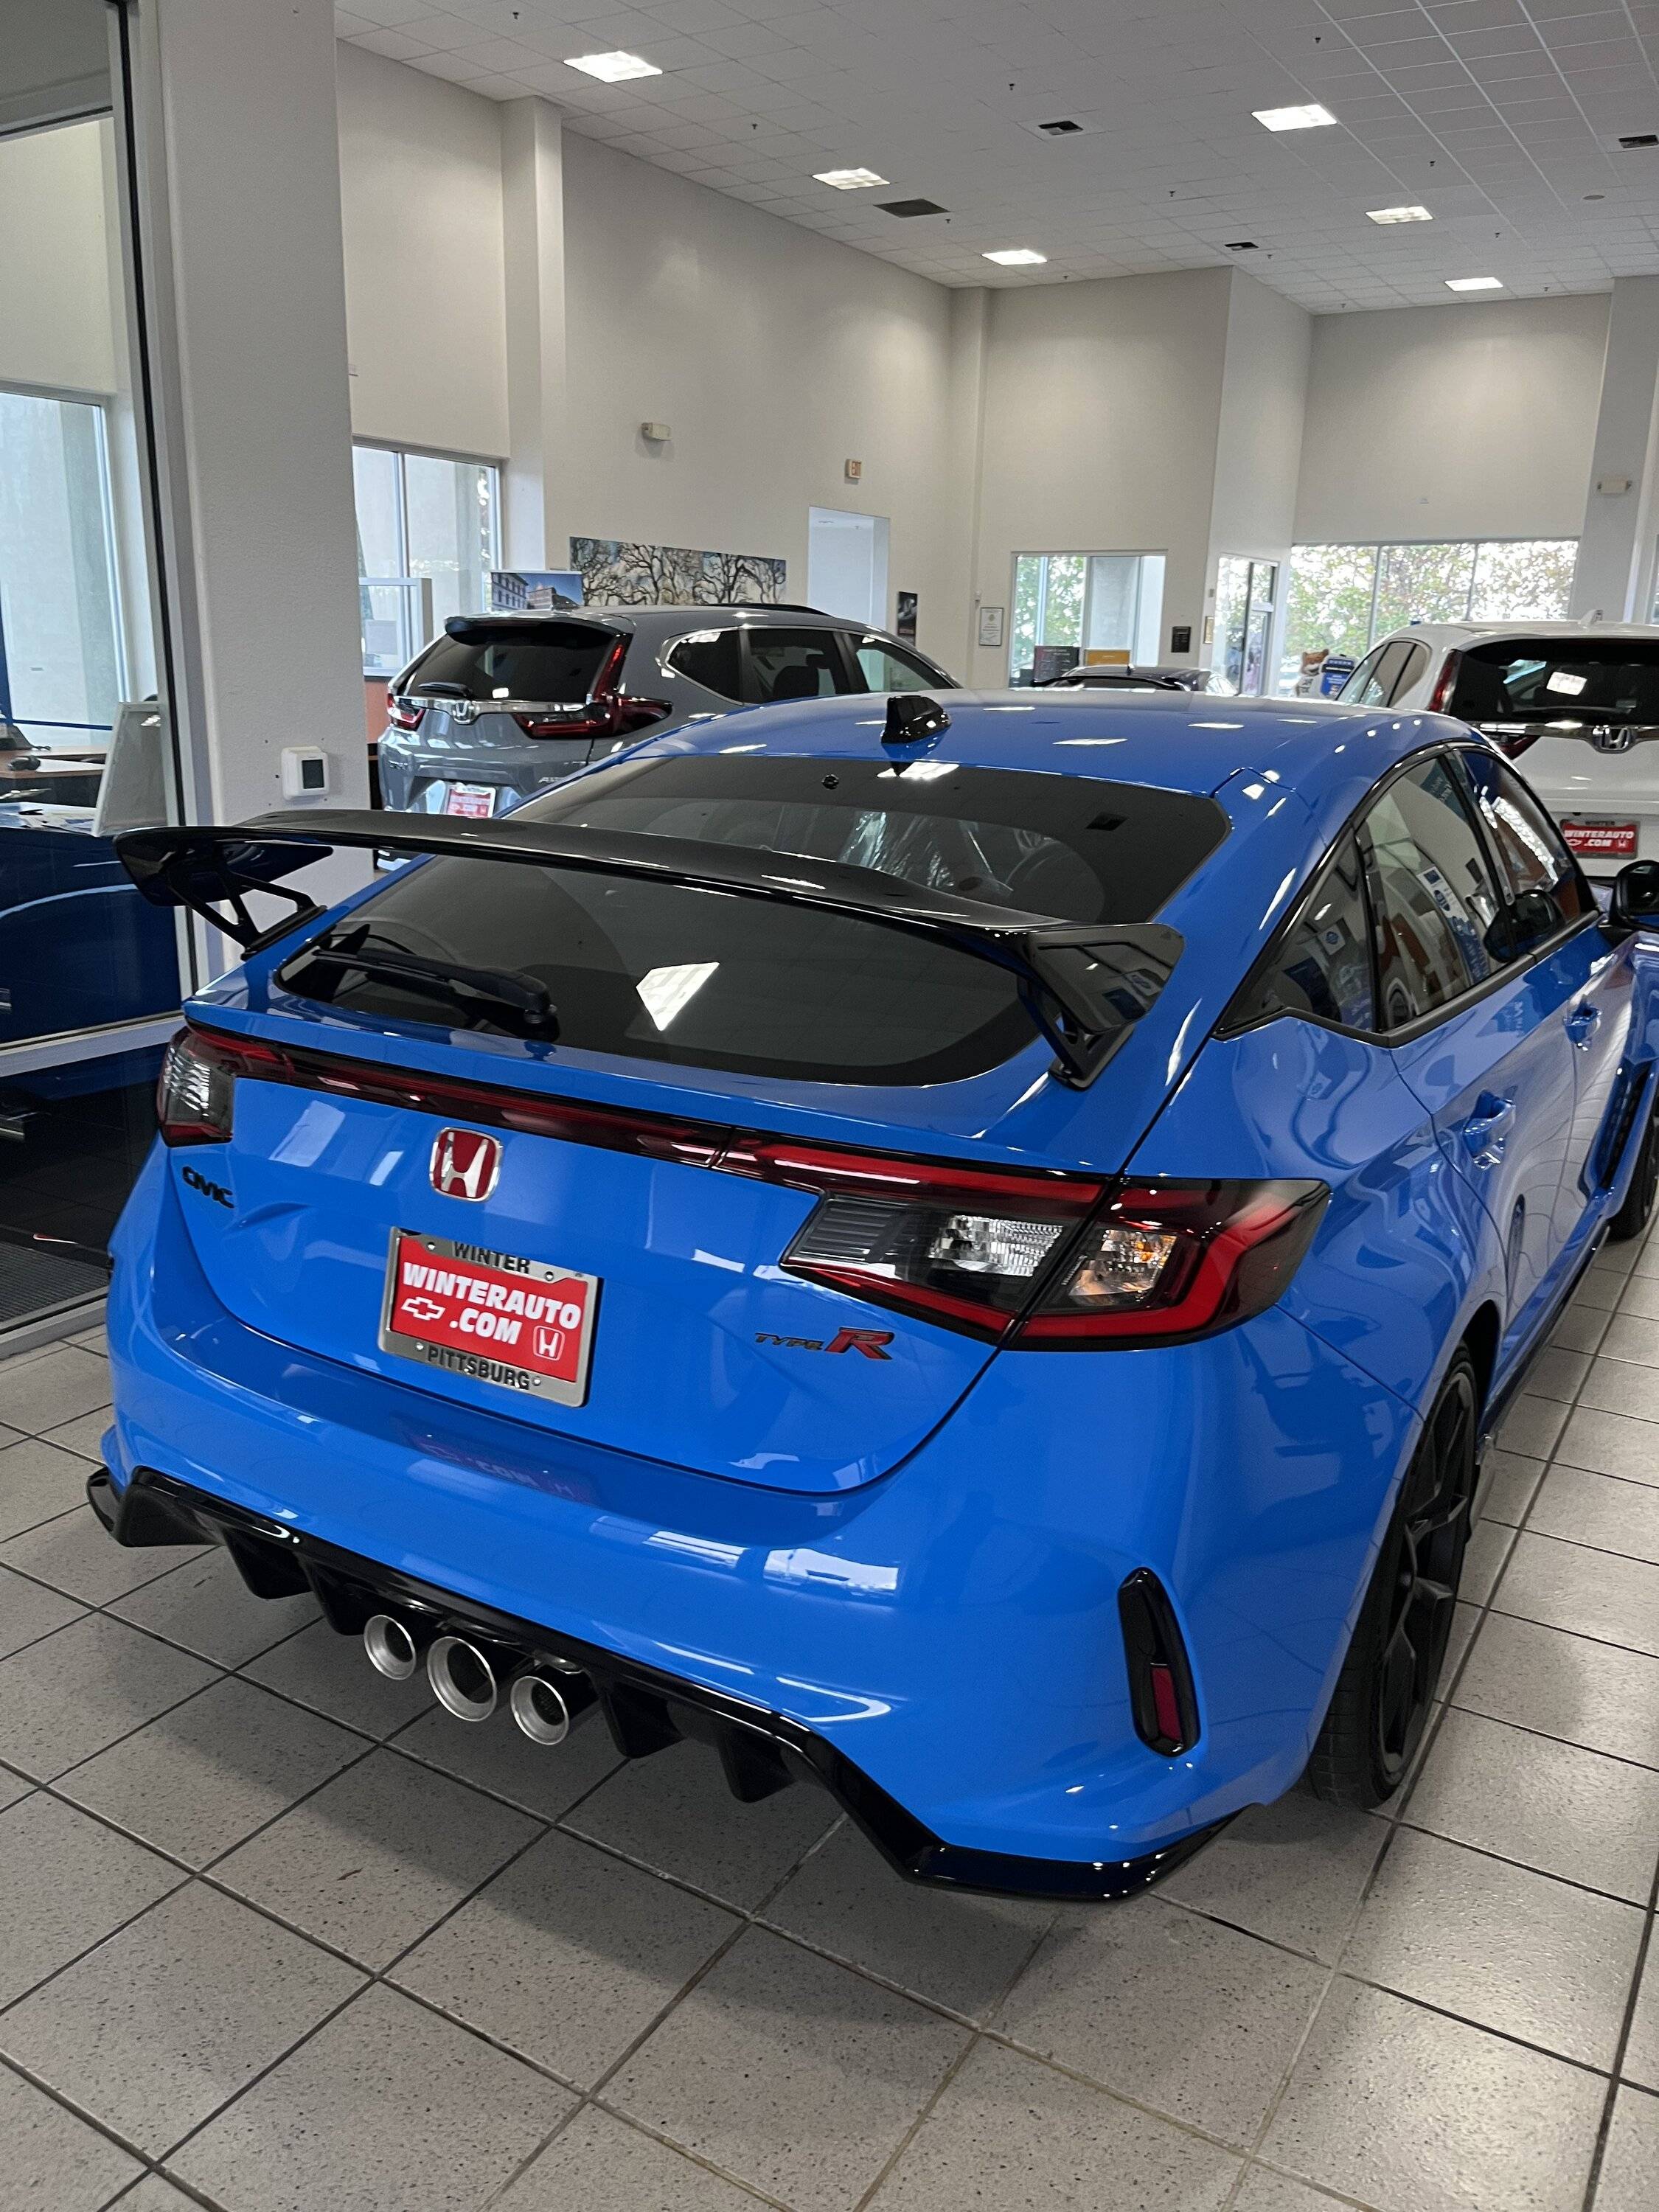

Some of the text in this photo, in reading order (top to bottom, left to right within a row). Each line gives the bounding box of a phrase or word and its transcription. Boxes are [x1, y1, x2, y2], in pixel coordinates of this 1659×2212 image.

[1564, 830, 1635, 839] WINTERAUTO
[1584, 839, 1612, 847] .COM
[182, 1166, 234, 1208] CIVIC
[453, 1241, 530, 1274] WINTER
[403, 1262, 582, 1329] WINTERAUTO
[449, 1307, 523, 1345] .COM
[755, 1326, 895, 1360] TYPE R
[427, 1345, 530, 1391] PITTSBURG
